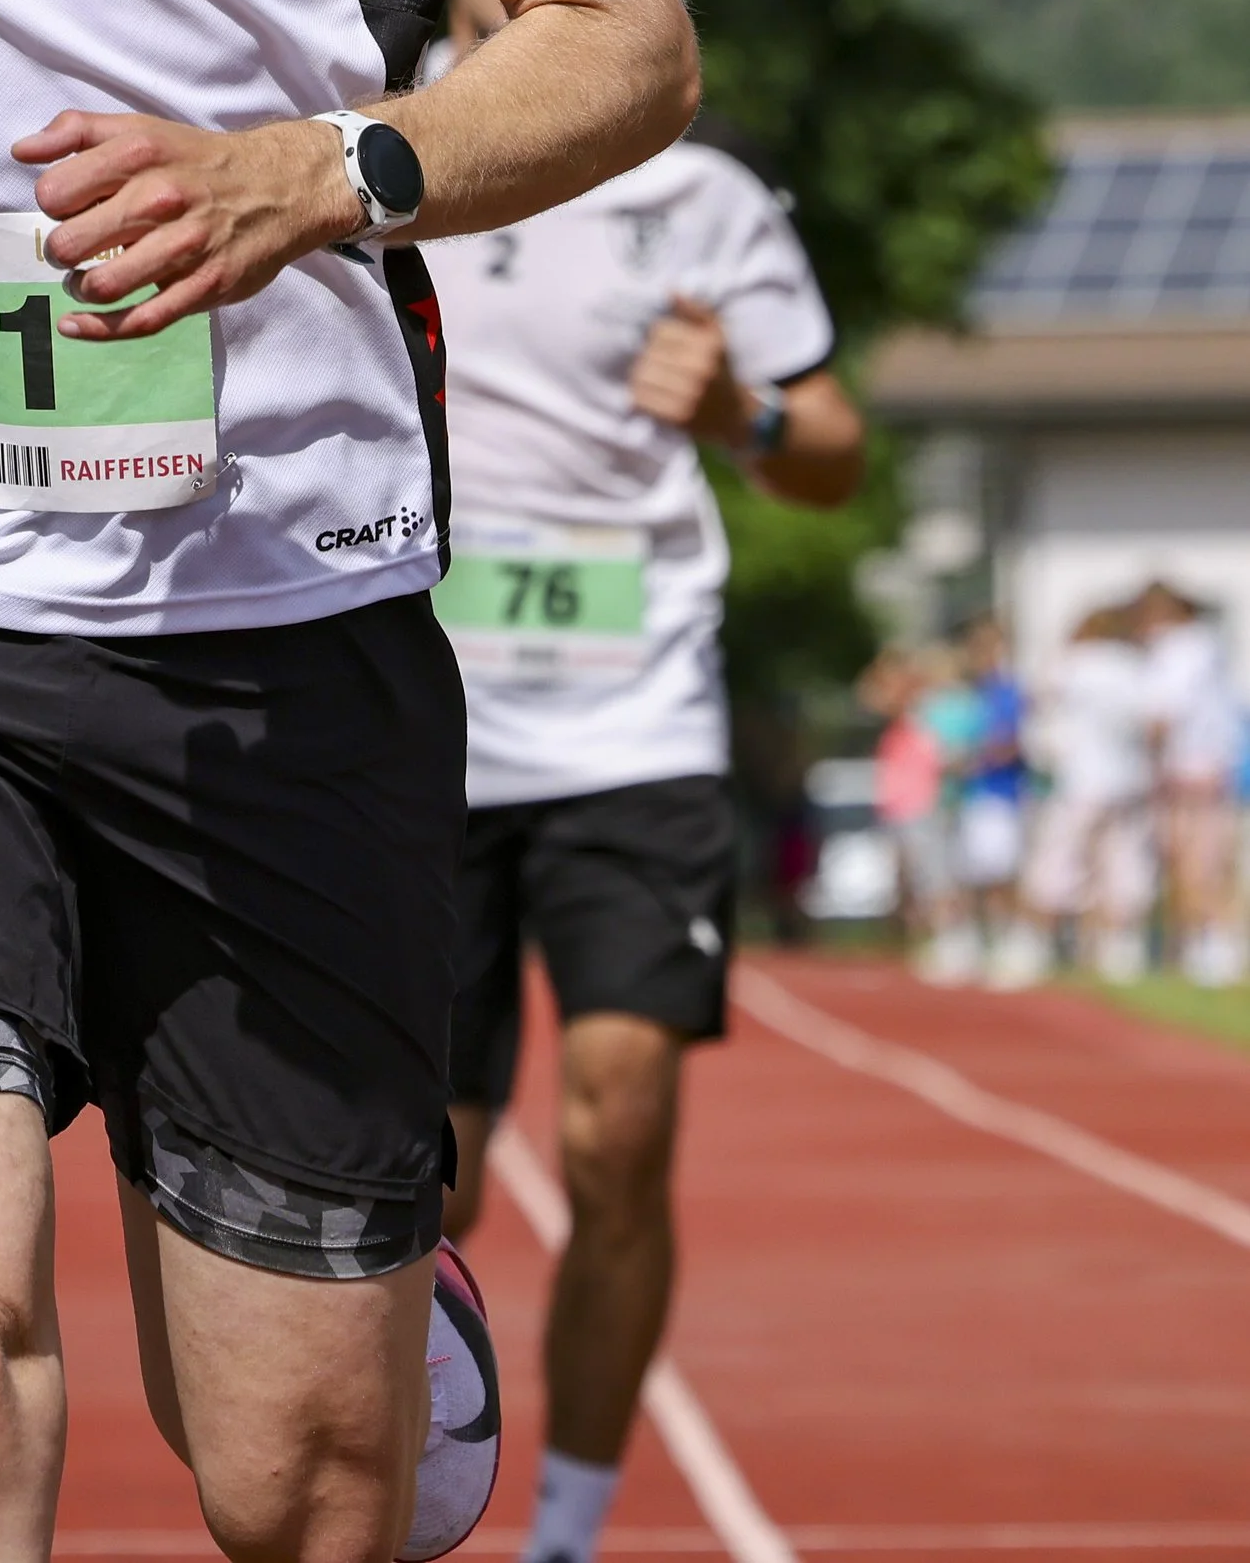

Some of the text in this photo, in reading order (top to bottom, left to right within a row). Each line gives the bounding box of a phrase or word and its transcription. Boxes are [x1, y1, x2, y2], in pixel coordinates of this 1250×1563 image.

[60, 453, 205, 483] RAIFFEISEN
[315, 514, 397, 553] CRAFT
[497, 560, 582, 628] 76
